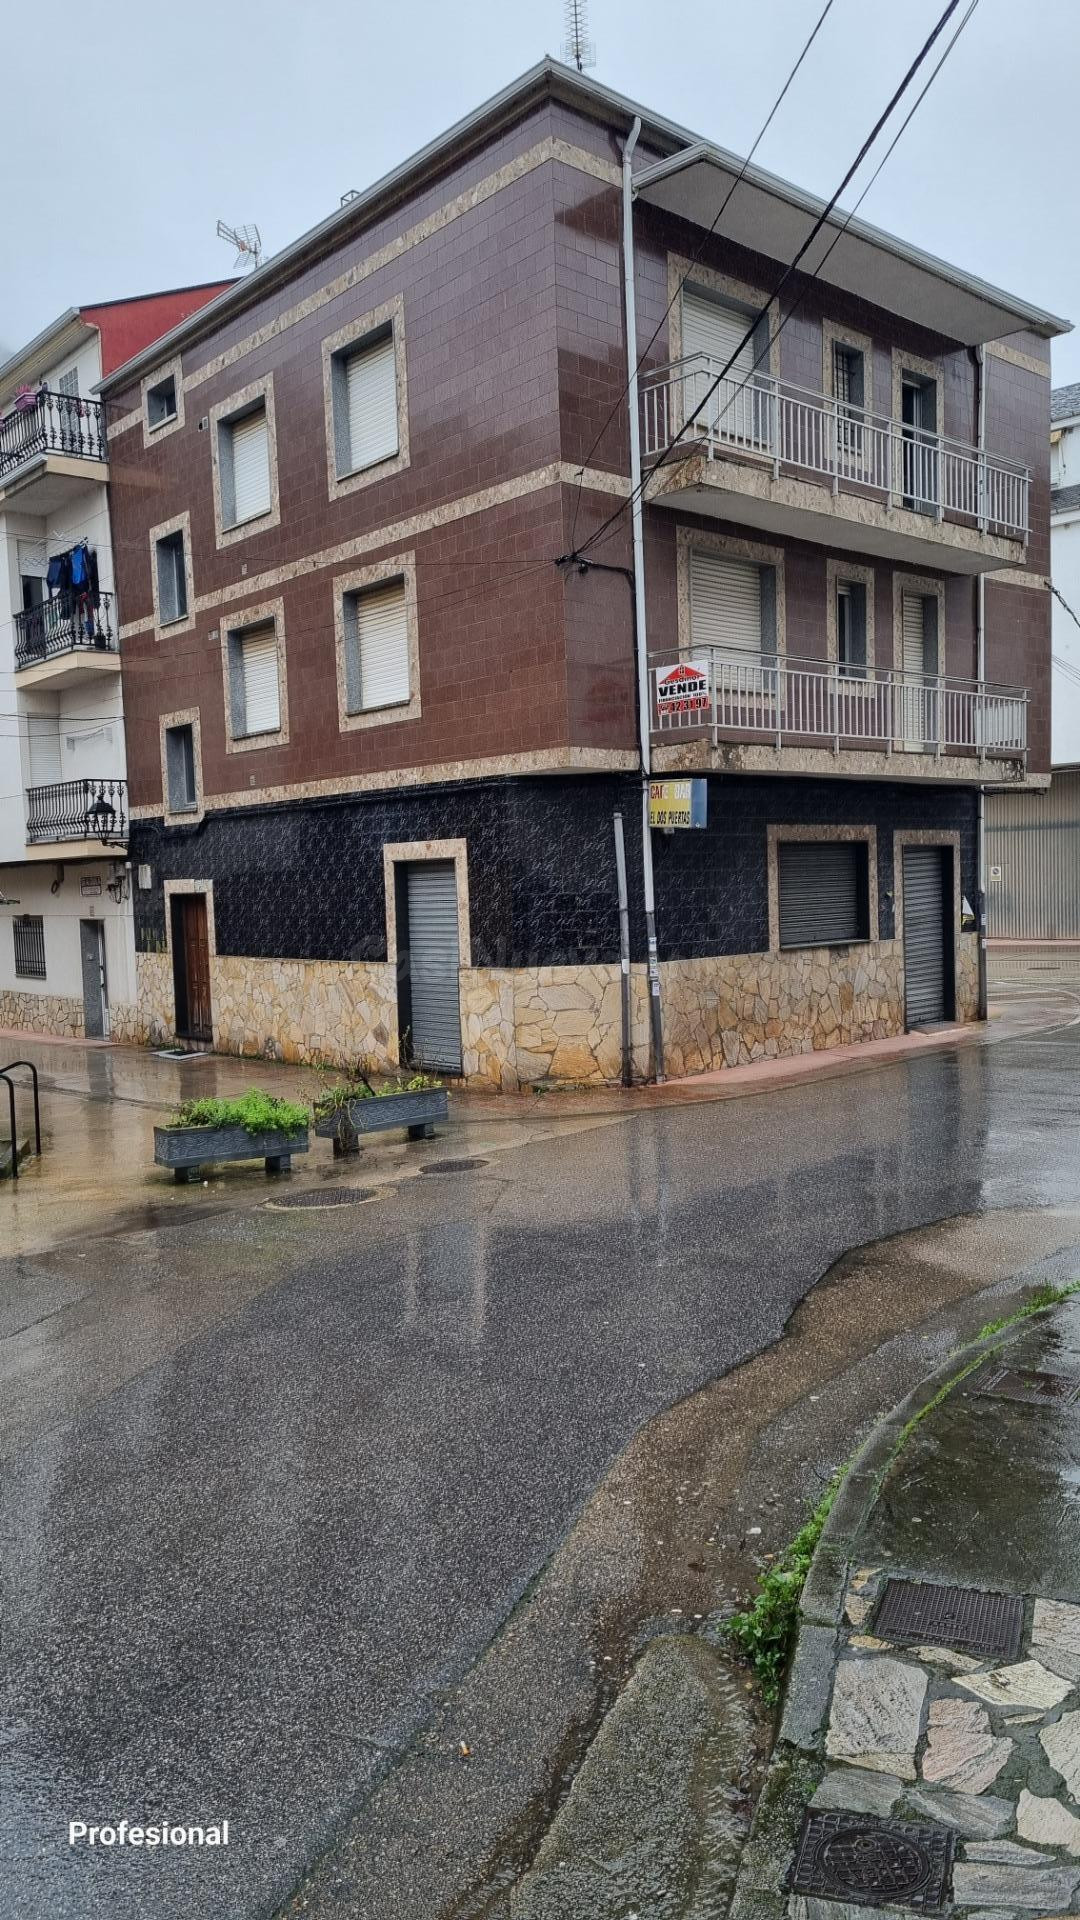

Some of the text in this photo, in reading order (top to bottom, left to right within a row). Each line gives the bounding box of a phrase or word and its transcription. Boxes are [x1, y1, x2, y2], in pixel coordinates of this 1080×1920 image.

[658, 680, 707, 697] VENDE
[650, 810, 690, 824] EL DOS PUERTAS
